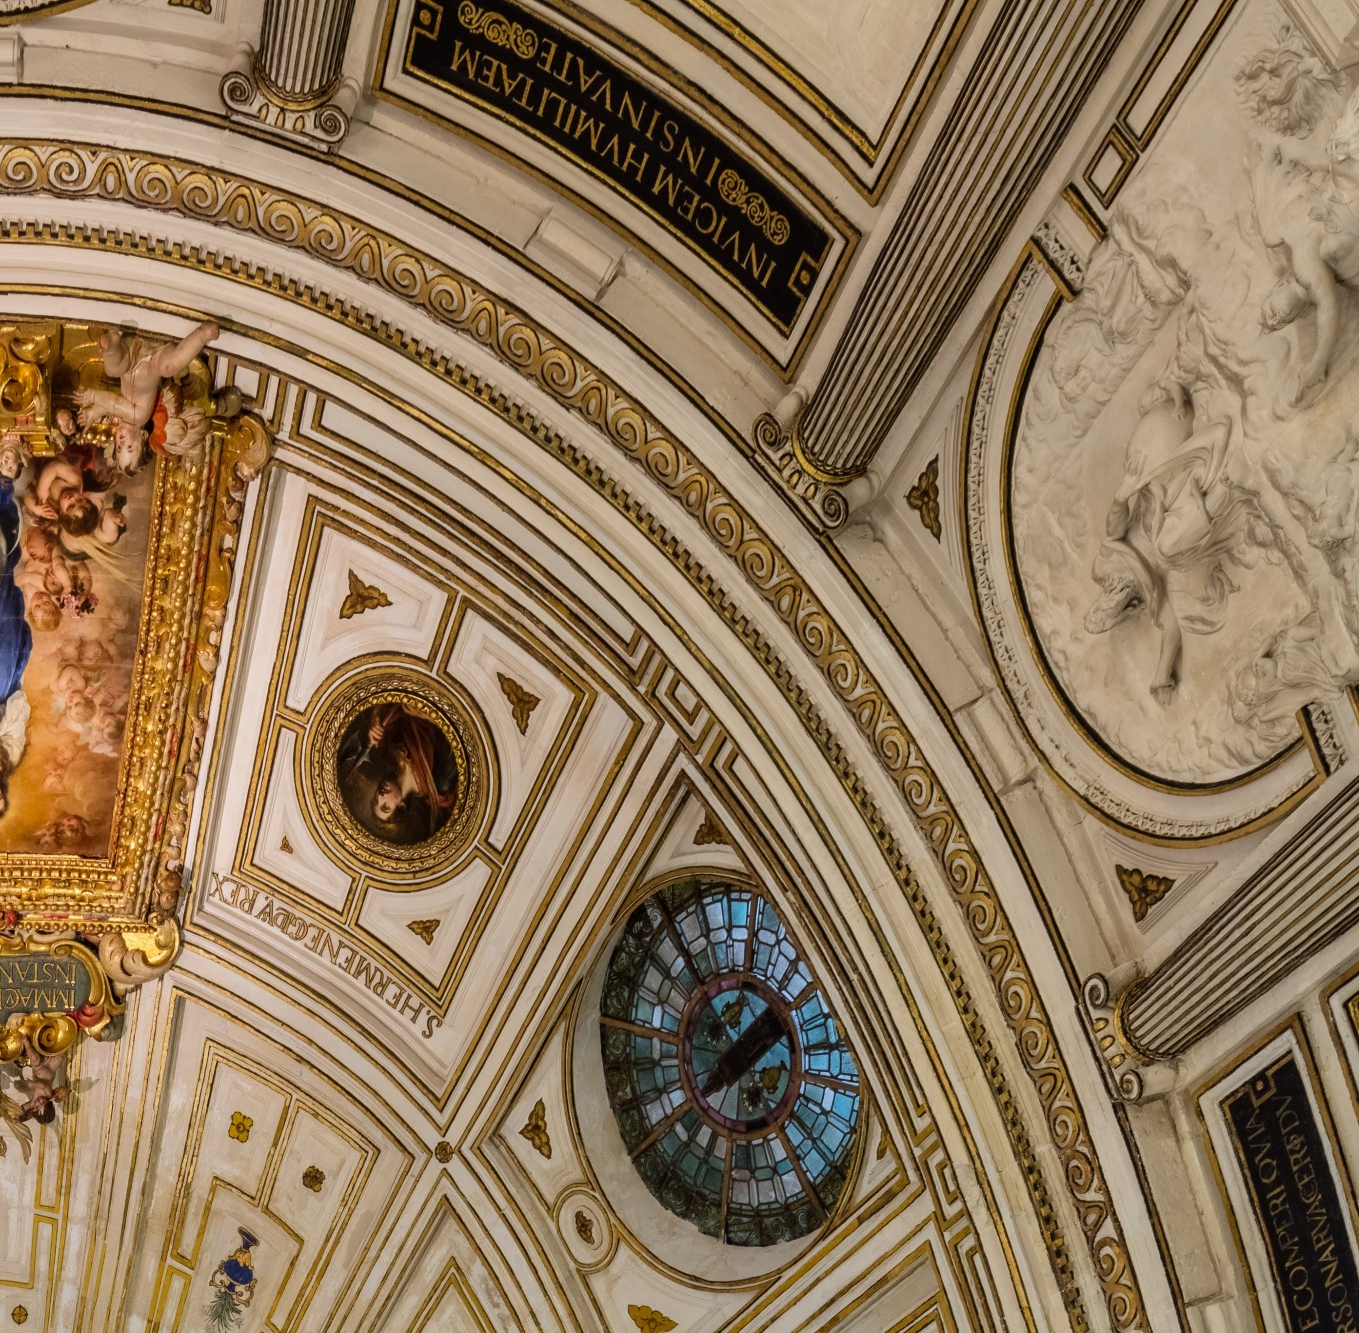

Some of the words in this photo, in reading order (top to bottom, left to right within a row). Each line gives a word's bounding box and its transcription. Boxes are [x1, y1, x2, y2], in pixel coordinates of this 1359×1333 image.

[536, 38, 720, 185] INSINVATE
[651, 164, 776, 287] INVICEM
[200, 870, 260, 914] REX
[417, 1009, 444, 1039] S.
[1246, 1106, 1277, 1183] QVIA
